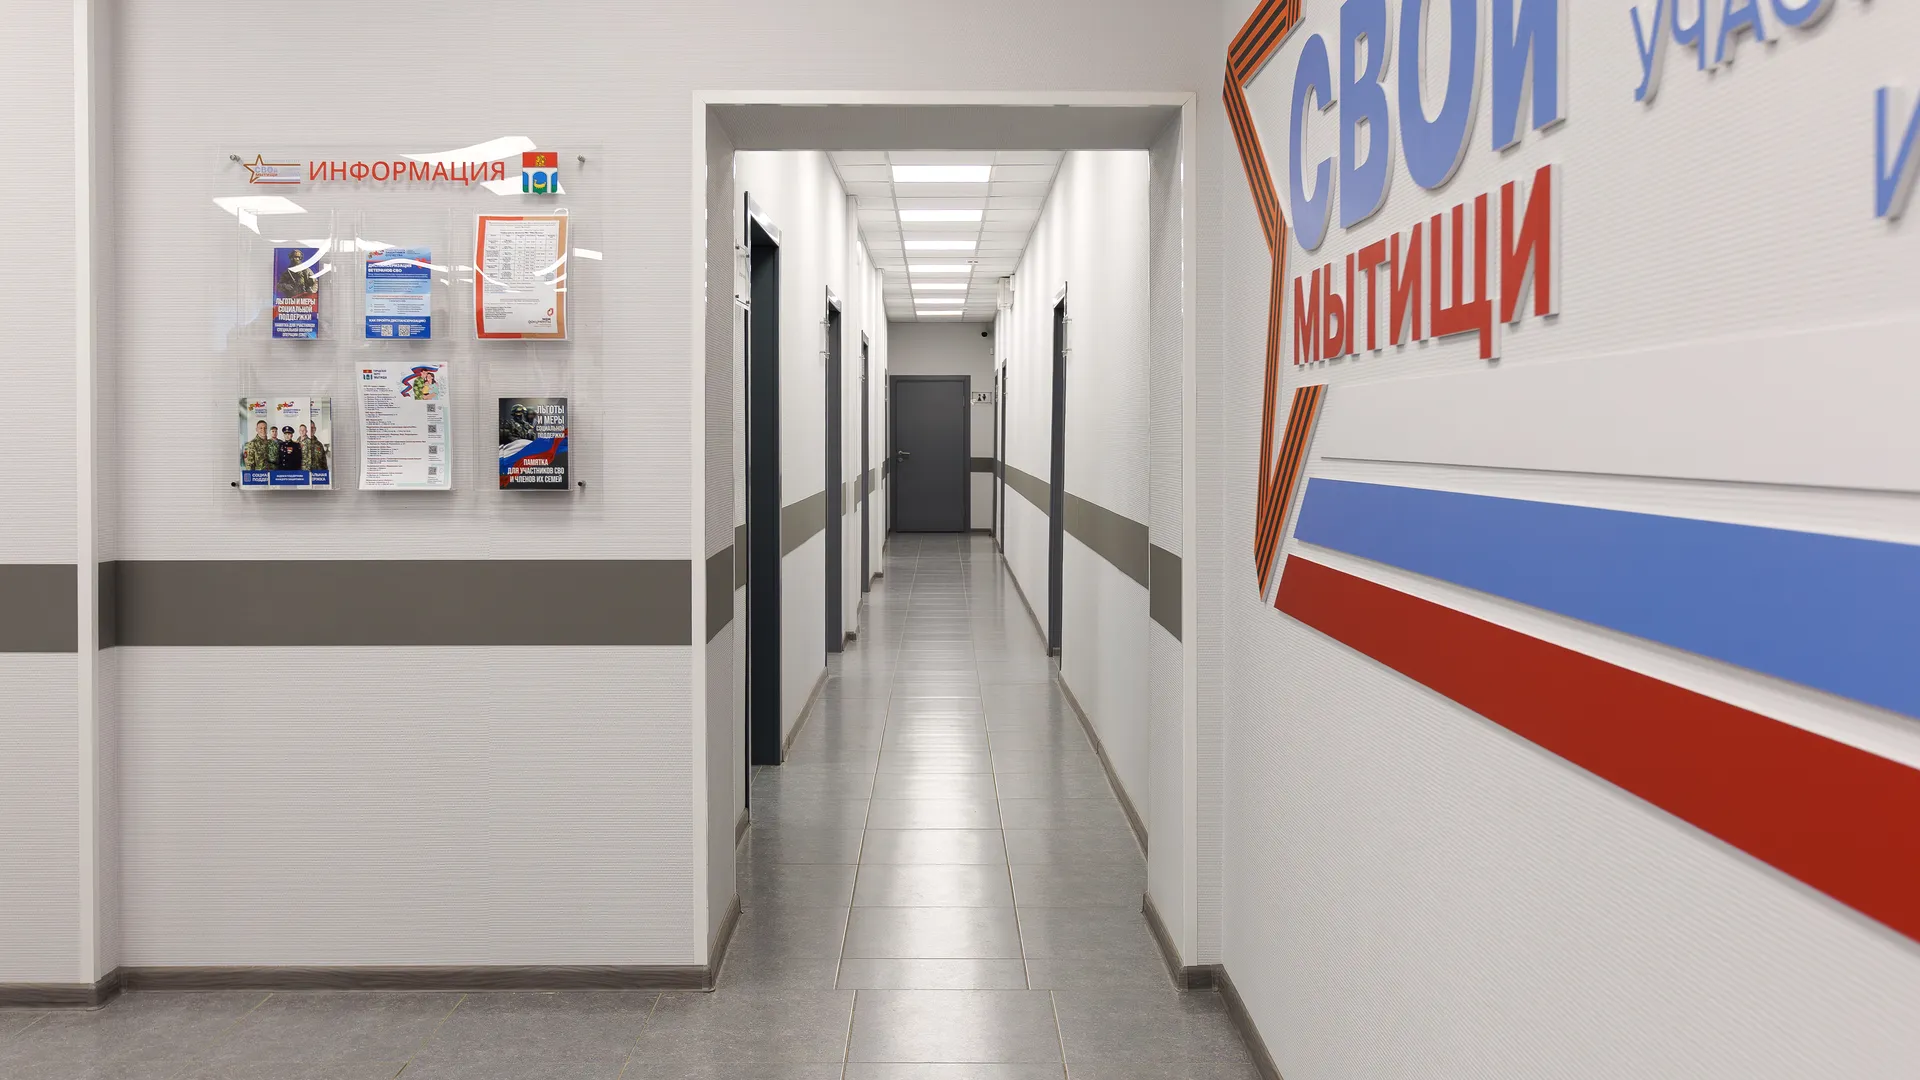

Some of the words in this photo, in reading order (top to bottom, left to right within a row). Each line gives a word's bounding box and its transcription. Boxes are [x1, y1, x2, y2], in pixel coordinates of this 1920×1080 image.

[309, 161, 505, 186] ИНФОРМАЦИЯ
[1294, 163, 1557, 366] МЫТИЩИ
[536, 405, 565, 414] ЛЬГОТЫ
[537, 415, 543, 424] И
[544, 415, 565, 424] МЕРЫ
